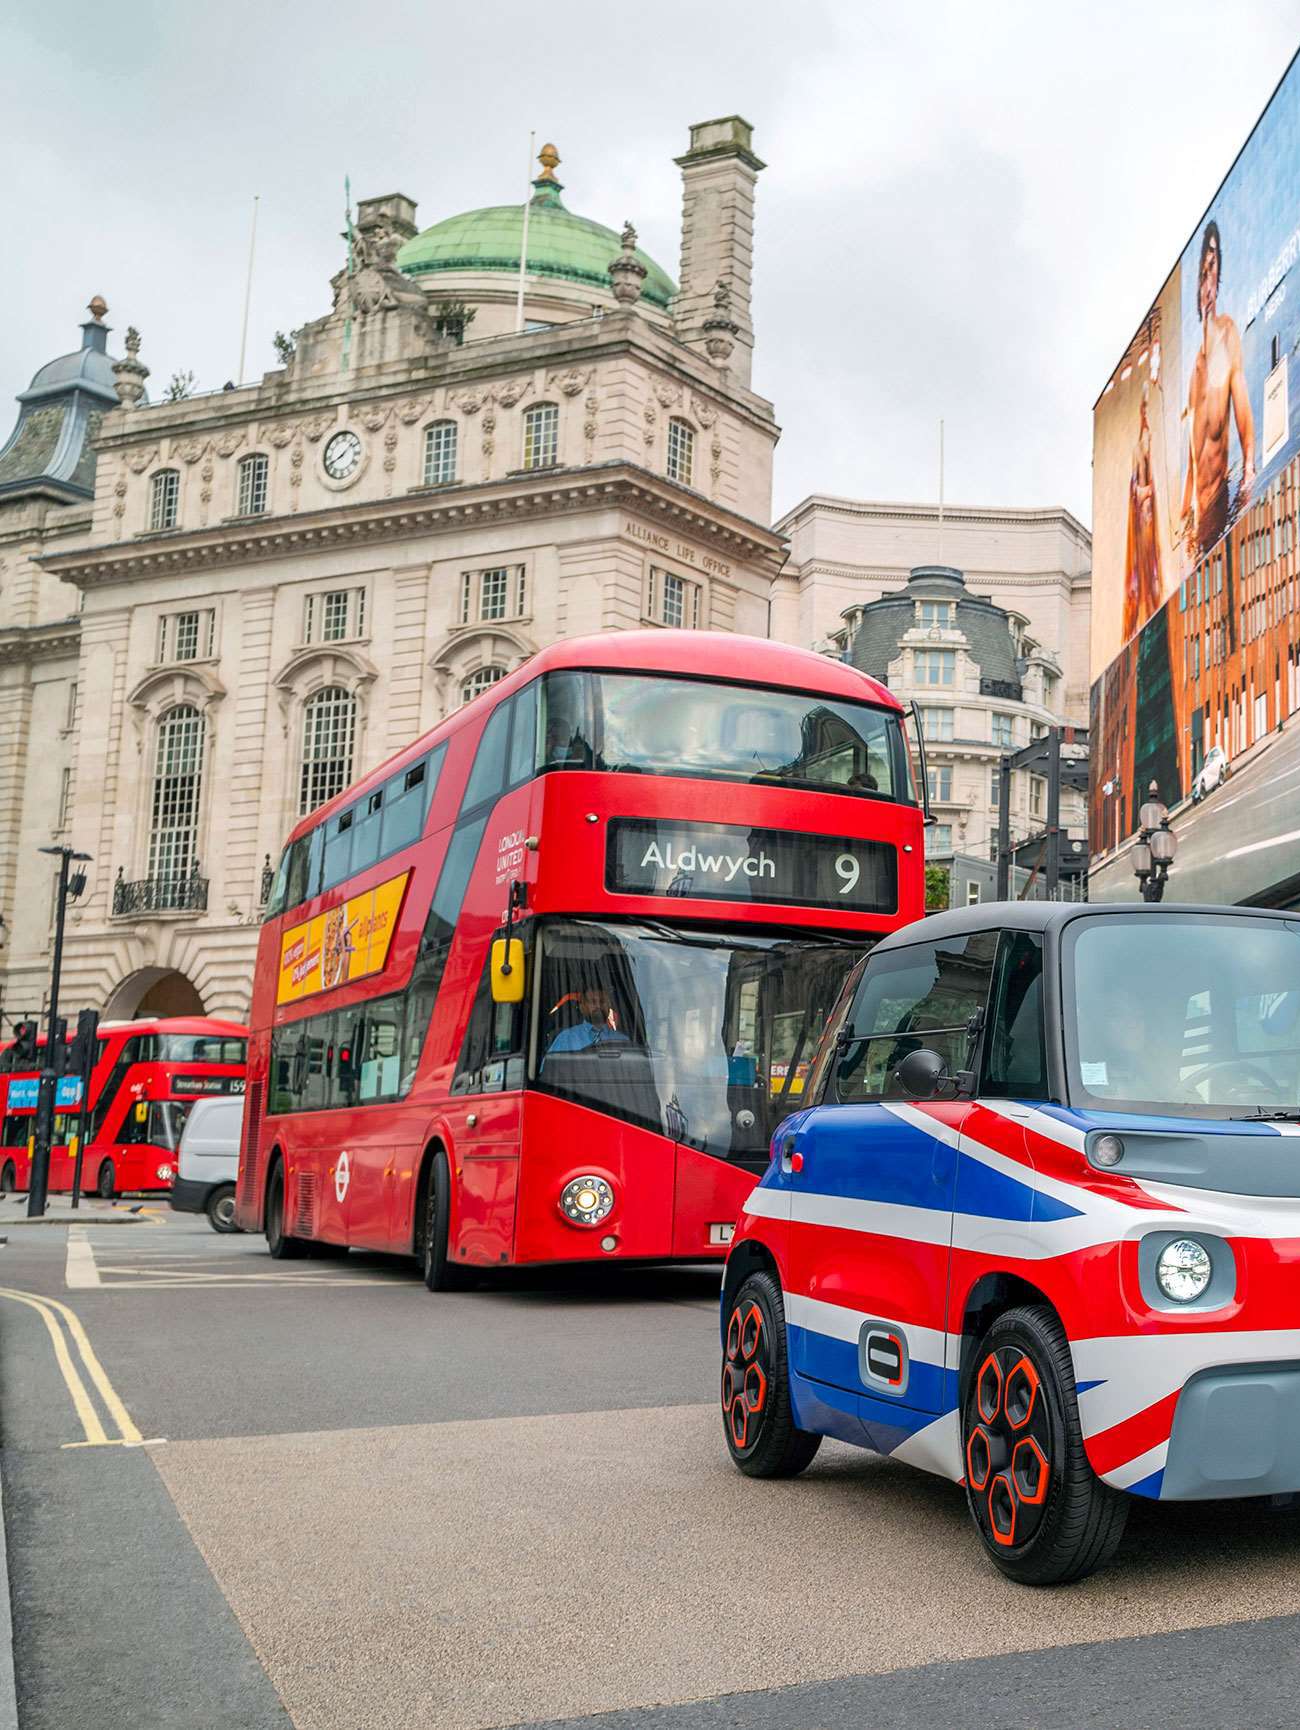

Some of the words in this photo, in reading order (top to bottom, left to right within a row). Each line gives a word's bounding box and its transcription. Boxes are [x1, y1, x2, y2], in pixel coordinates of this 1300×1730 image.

[625, 521, 670, 552] ALLIANCE
[676, 543, 696, 563] LIFE
[702, 555, 732, 578] OFFICE
[496, 848, 524, 872] UNITED
[640, 841, 776, 882] Aldwych
[834, 852, 861, 894] 9
[229, 1080, 246, 1093] 159
